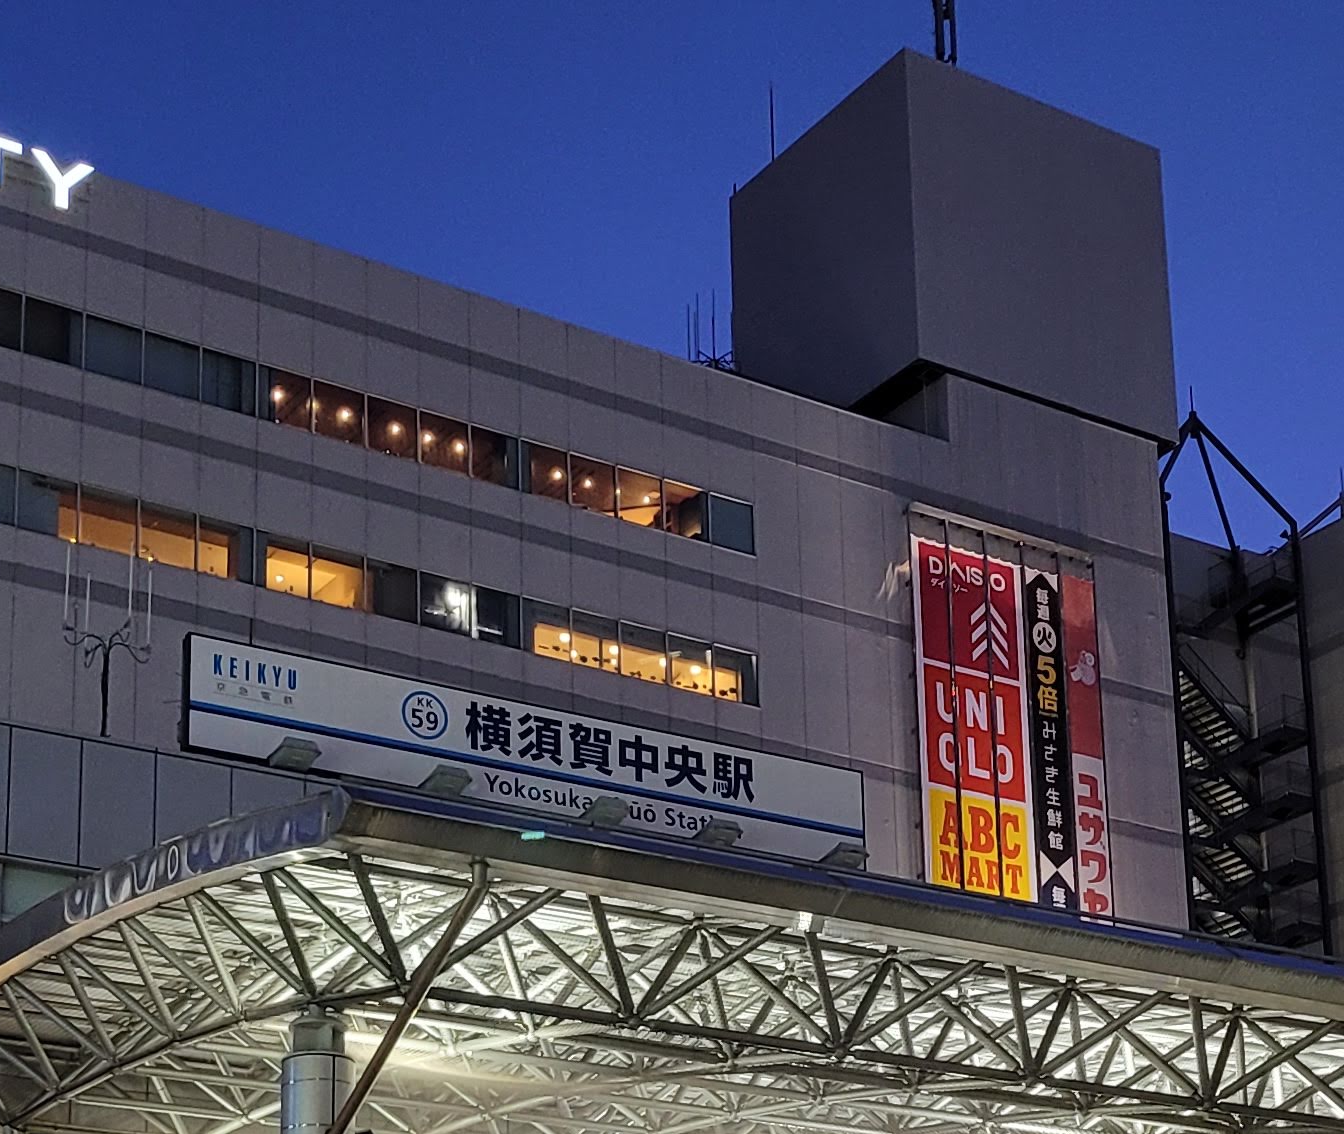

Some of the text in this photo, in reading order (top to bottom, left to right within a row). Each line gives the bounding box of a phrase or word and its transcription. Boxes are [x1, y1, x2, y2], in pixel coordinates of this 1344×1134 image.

[928, 555, 1006, 592] DAISO
[213, 653, 297, 691] KEIKYU
[410, 708, 439, 731] 59
[417, 696, 434, 710] KK
[935, 681, 1006, 736] UNI
[465, 700, 755, 803] 横須賀中央駅
[938, 732, 1014, 784] QLO
[484, 772, 657, 823] Yokosukaūō
[1042, 720, 1064, 850] みさき生鮮館
[939, 800, 1022, 860] ABC
[1077, 772, 1110, 917] ユザワヤ
[939, 849, 1023, 895] MART
